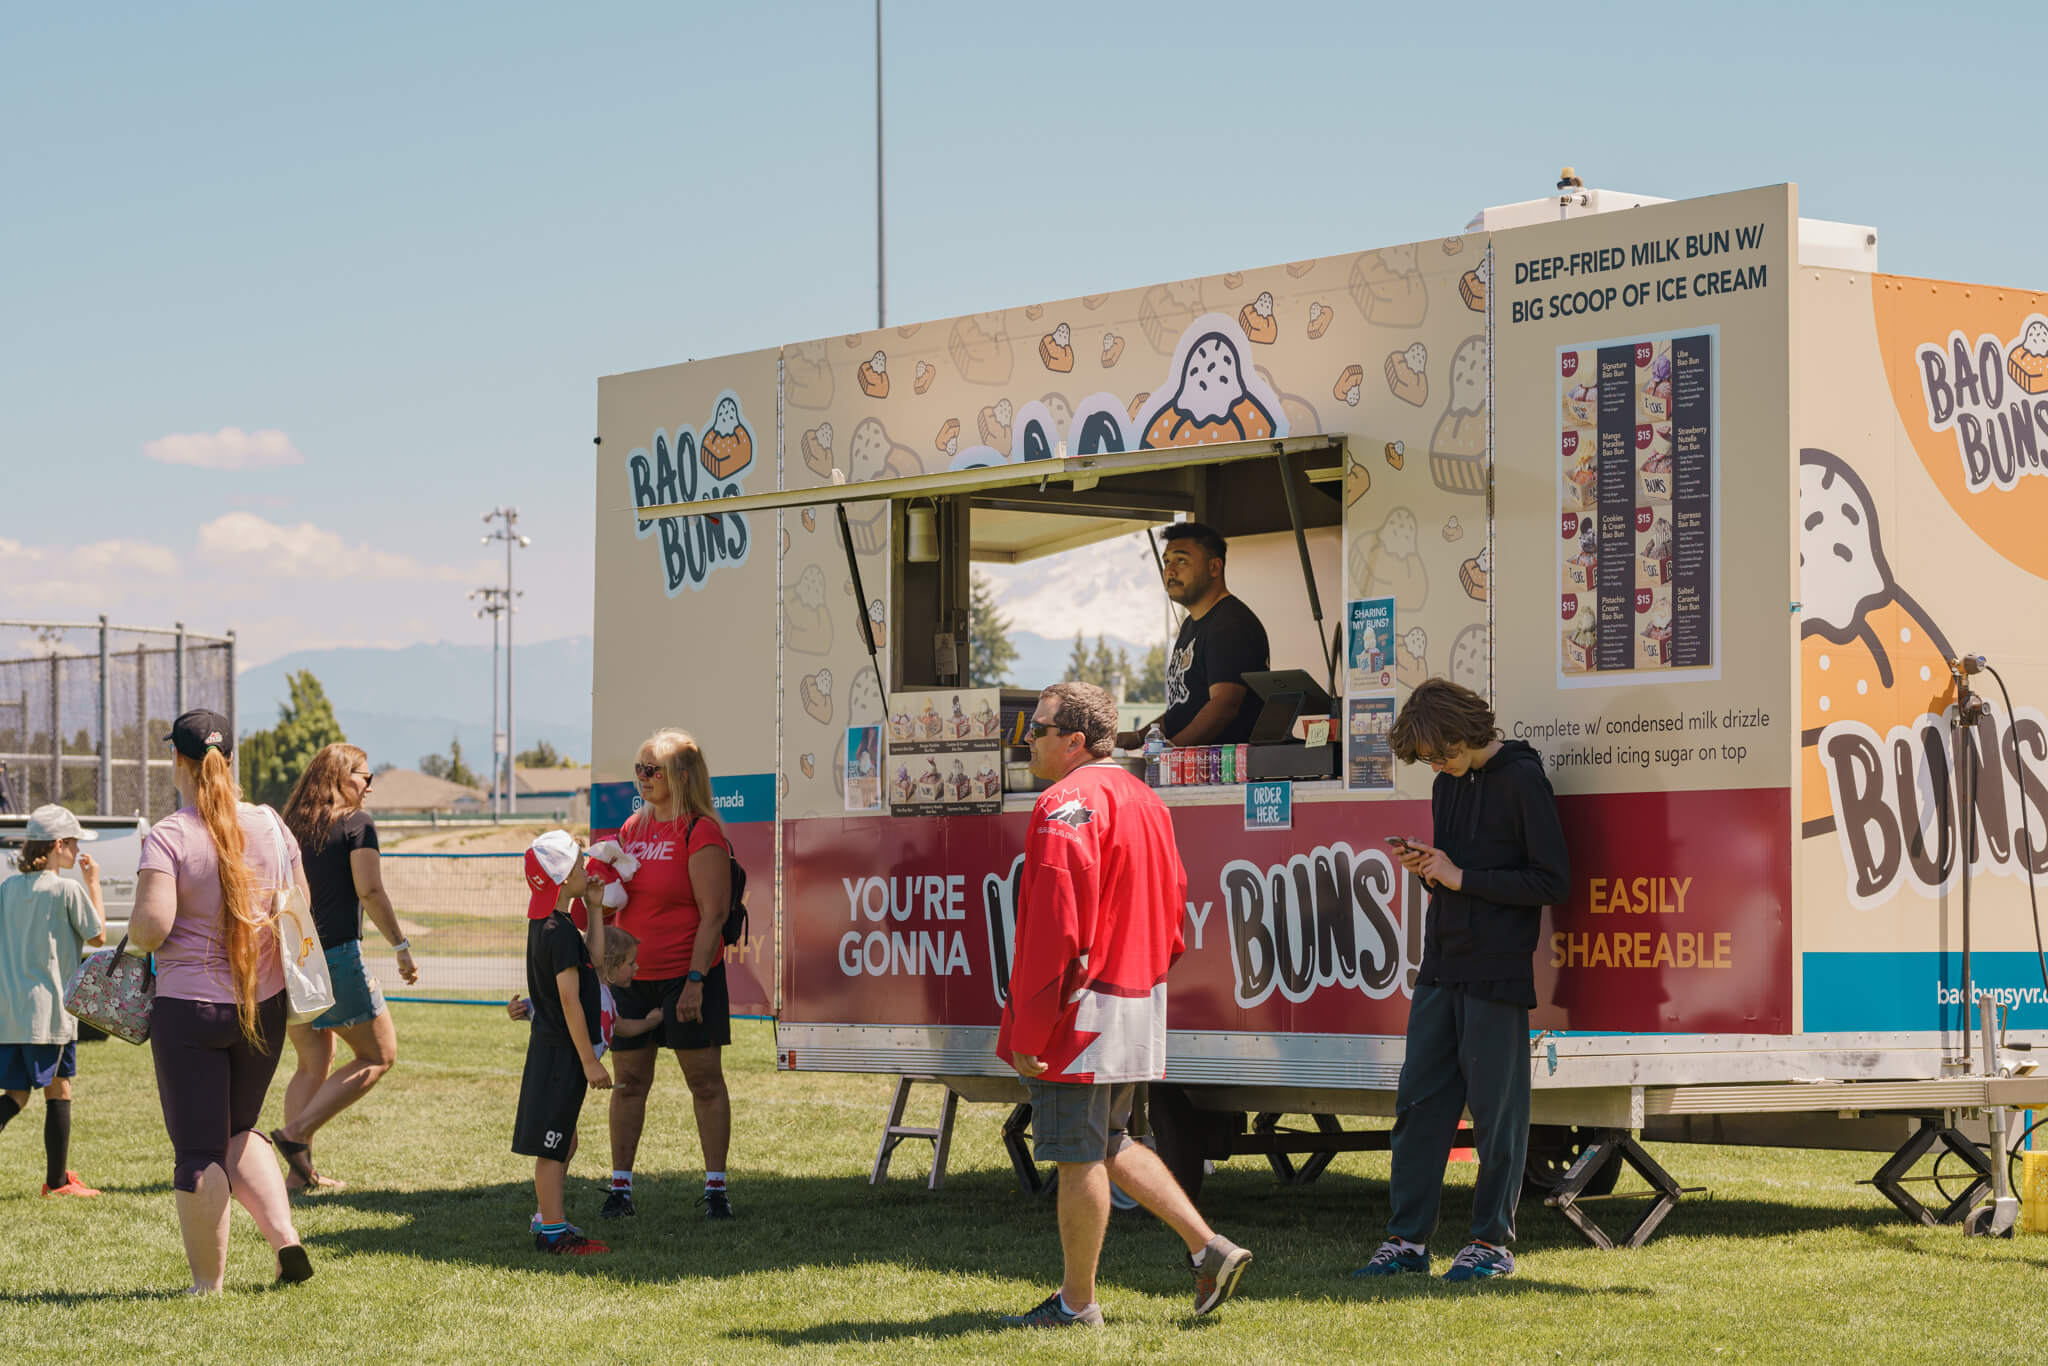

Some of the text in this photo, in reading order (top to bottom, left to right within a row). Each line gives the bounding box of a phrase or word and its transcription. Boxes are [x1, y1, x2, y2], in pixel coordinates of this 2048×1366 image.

[1515, 223, 1765, 285] DEEP-FRIED MILK BUN W/
[1512, 265, 1767, 324] BIG SCOOP OF ICE CREAM
[1636, 348, 1650, 359] $15
[1562, 358, 1576, 369] $12
[1921, 338, 2003, 423] BAO
[1563, 437, 1576, 448] $15
[1638, 430, 1650, 441] $15
[630, 432, 698, 531] BAO
[1644, 478, 1666, 494] BUNS
[1563, 520, 1576, 531] $15
[1602, 515, 1624, 523] Cookies
[1637, 513, 1650, 523] $15
[659, 483, 747, 590] BUNS
[1562, 602, 1576, 612] $15
[1636, 594, 1650, 605] $15
[1354, 607, 1387, 619] SHARING
[1352, 618, 1389, 630] MY BUNS?
[1513, 708, 1770, 741] Complete w/ condensed milk drizzle
[1550, 746, 1612, 771] sprinkled
[1617, 746, 1650, 767] icing
[1654, 746, 1694, 768] sugar
[1699, 744, 1717, 761] on
[1722, 741, 1747, 764] top
[712, 790, 744, 808] anada
[1253, 787, 1282, 805] ORDER
[1256, 805, 1280, 823] HERE
[1589, 876, 1693, 914] EASILY
[842, 875, 966, 921] YOU'RE
[1183, 901, 1213, 949] Y
[839, 930, 972, 976] GONNA
[1549, 931, 1733, 969] SHAREABLE
